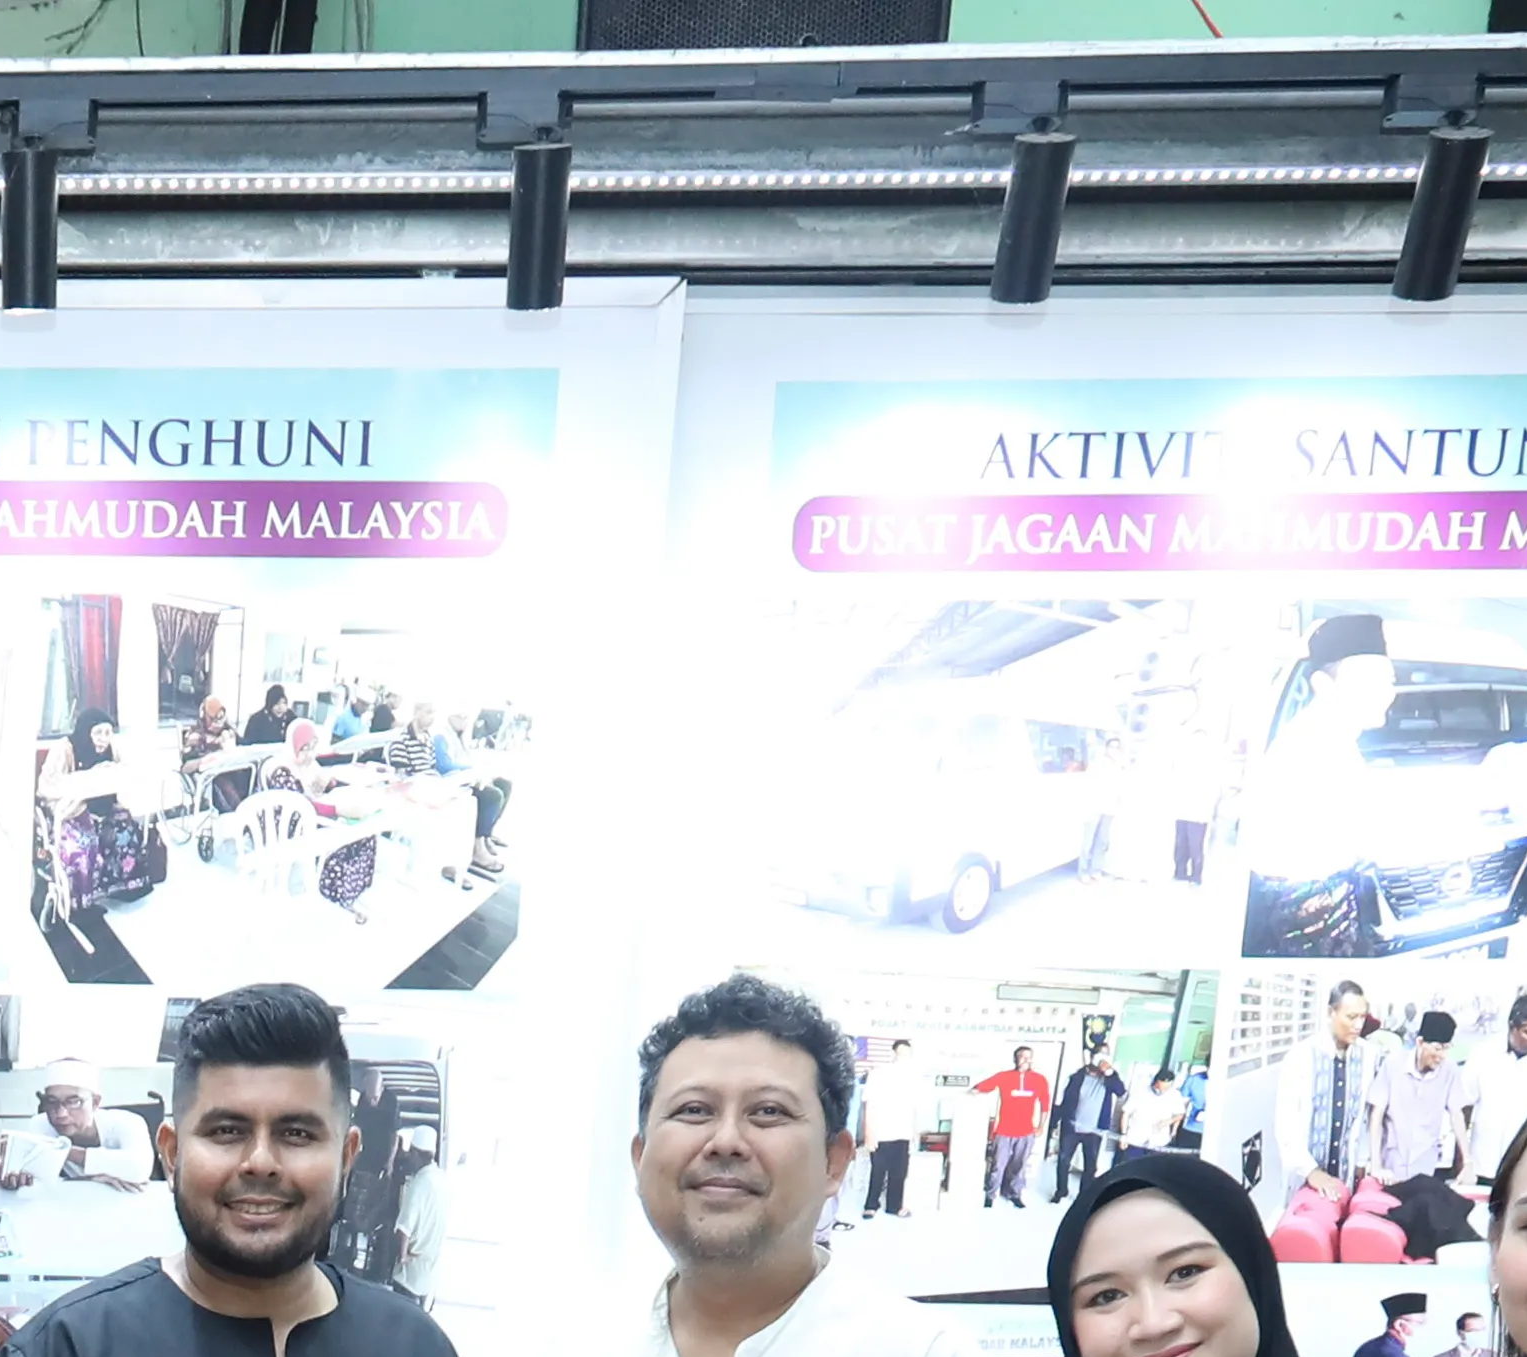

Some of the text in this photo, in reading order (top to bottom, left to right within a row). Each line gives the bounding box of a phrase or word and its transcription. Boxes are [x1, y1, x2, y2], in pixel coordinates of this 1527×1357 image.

[26, 418, 375, 468] PENGHUNI
[260, 499, 497, 540] MALAYSIA
[809, 514, 957, 554] PUSAT
[964, 512, 1157, 565] JAGAAN
